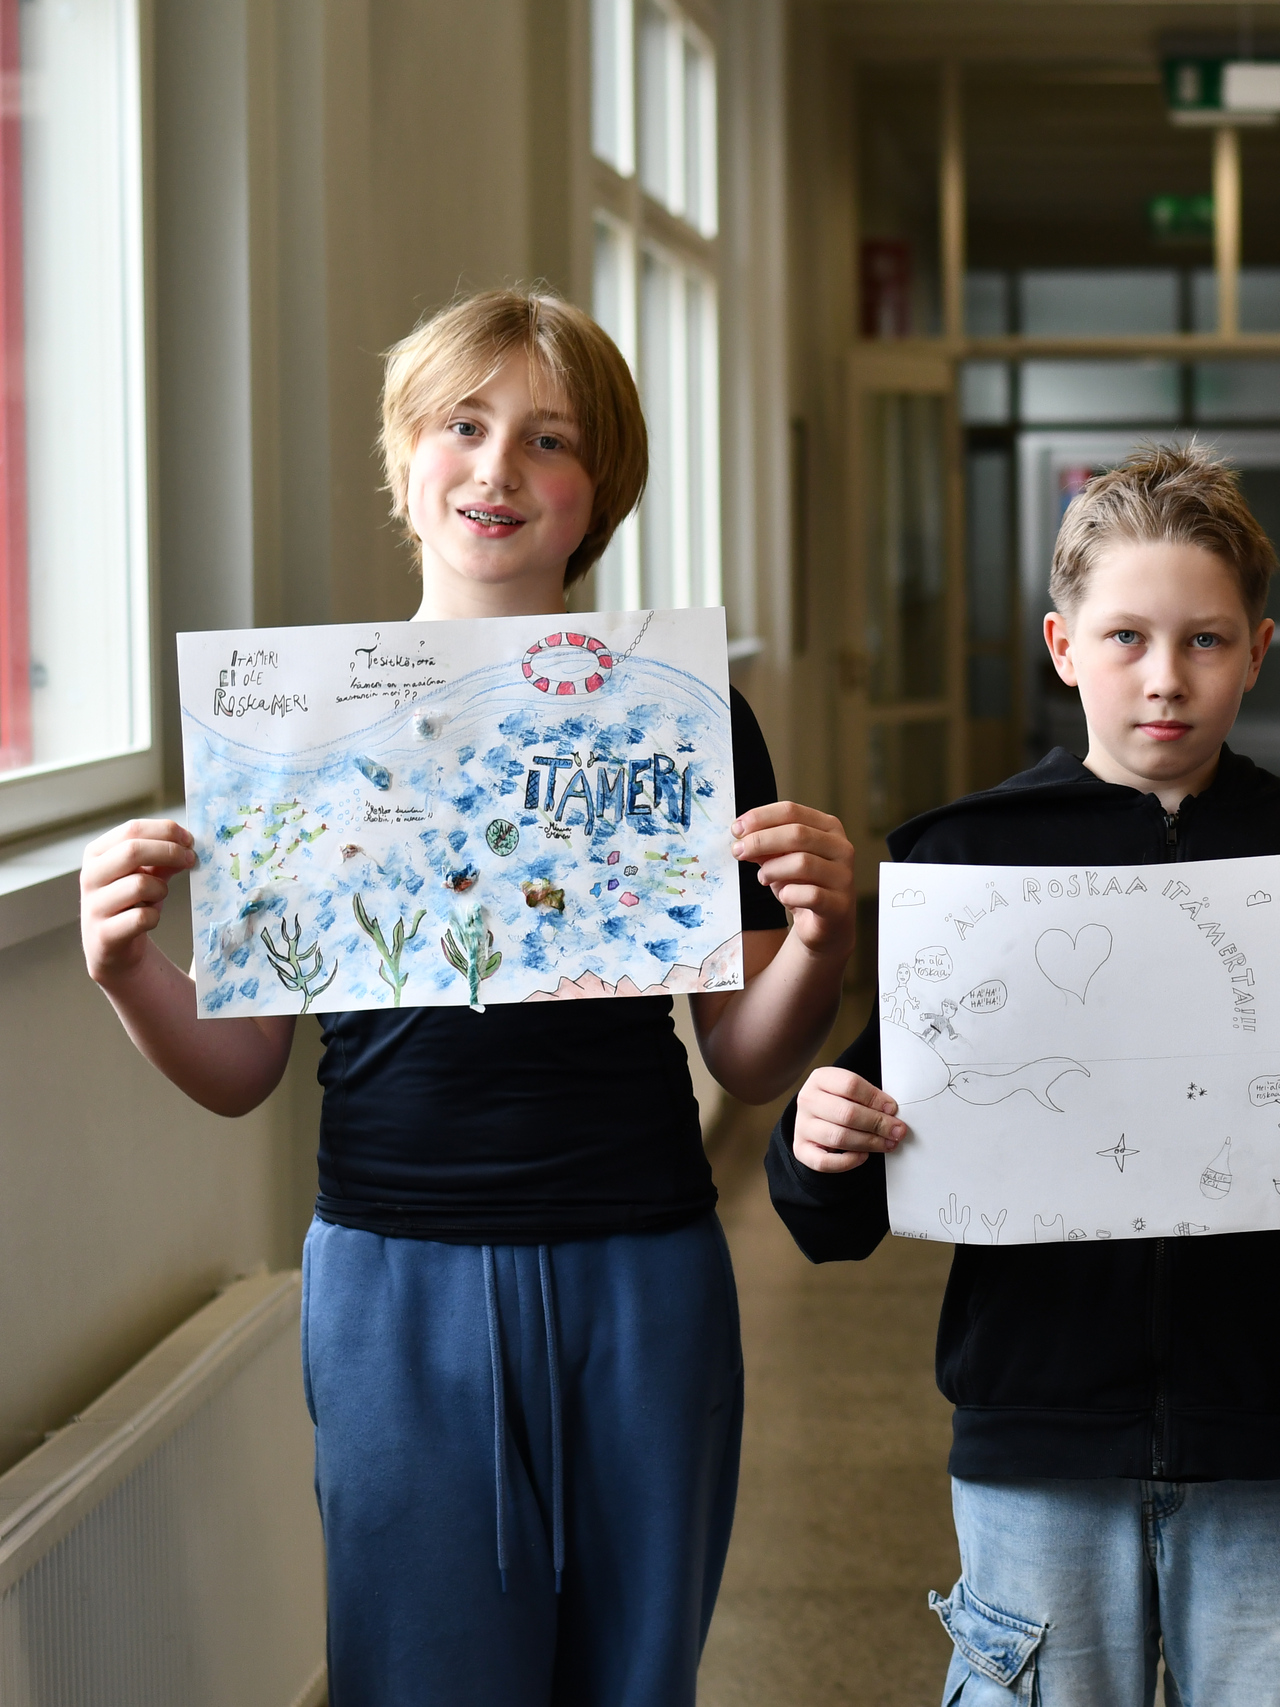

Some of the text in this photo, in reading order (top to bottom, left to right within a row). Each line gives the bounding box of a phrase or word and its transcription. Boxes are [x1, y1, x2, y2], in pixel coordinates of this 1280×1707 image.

[219, 669, 263, 687] EI OLE
[231, 650, 278, 668] ITÄMERI
[524, 752, 692, 835] ITÄMERI
[944, 881, 1010, 941] ÄLÄ
[1022, 871, 1148, 905] ROSKAA
